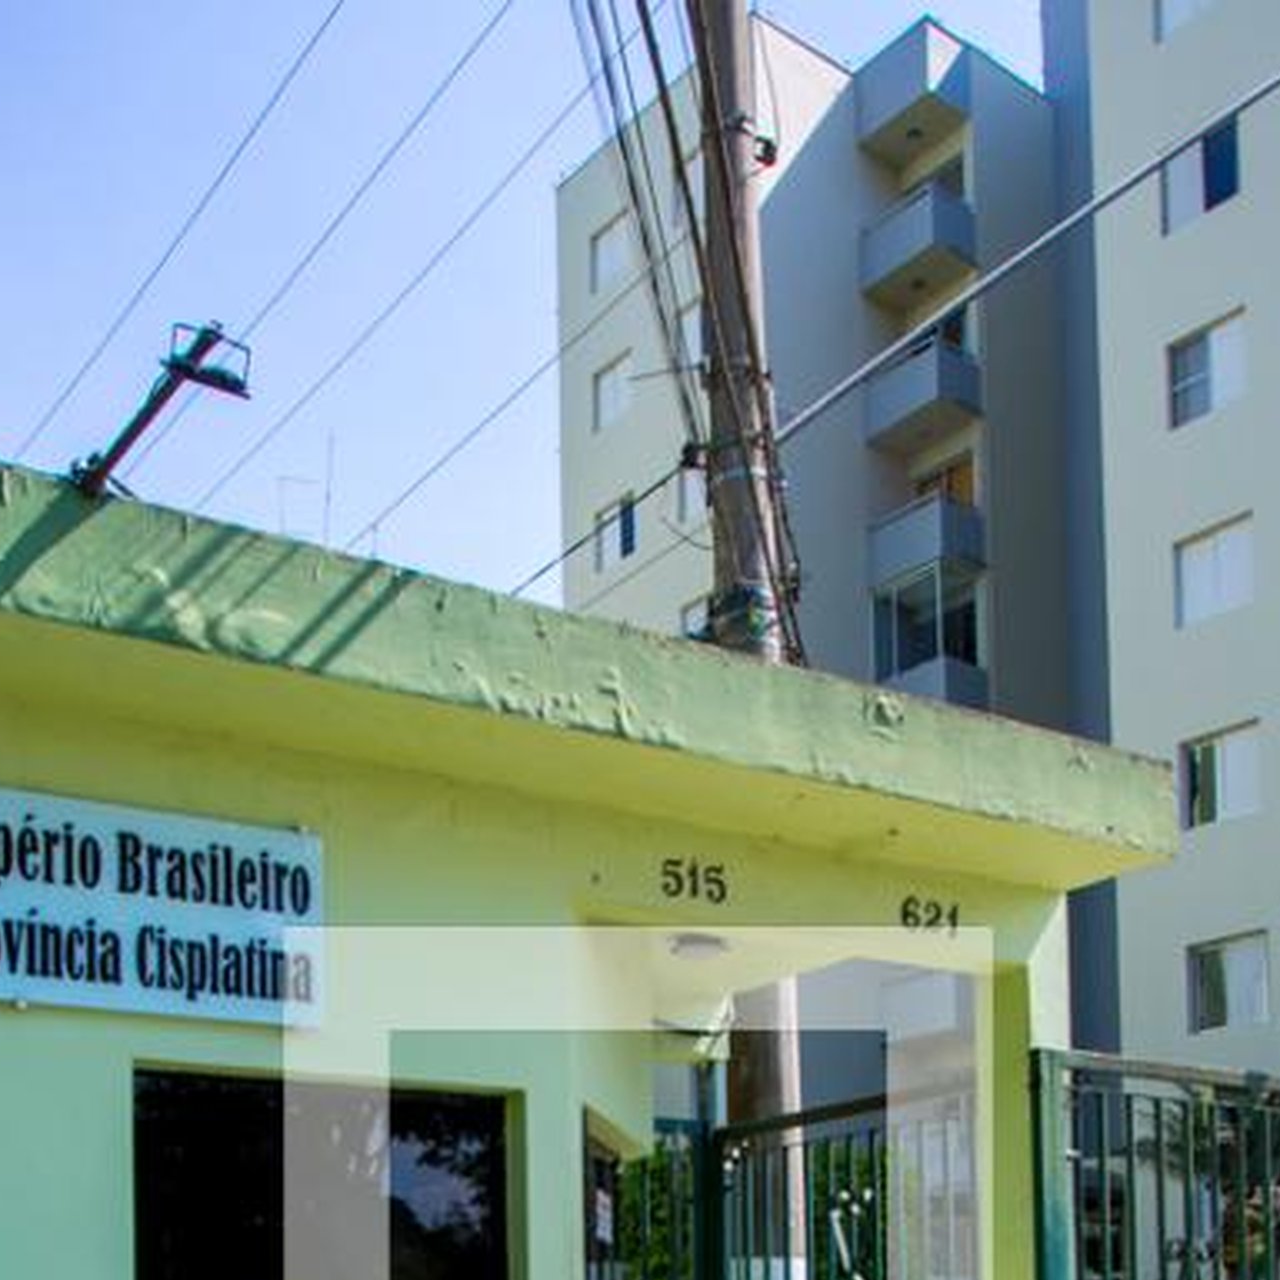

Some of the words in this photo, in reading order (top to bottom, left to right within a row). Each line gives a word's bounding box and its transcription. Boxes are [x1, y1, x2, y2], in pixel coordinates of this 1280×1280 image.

[116, 831, 311, 916] Brasileiro
[660, 858, 727, 904] 515
[900, 895, 960, 937] 621
[135, 924, 314, 1003] Cisplatina
